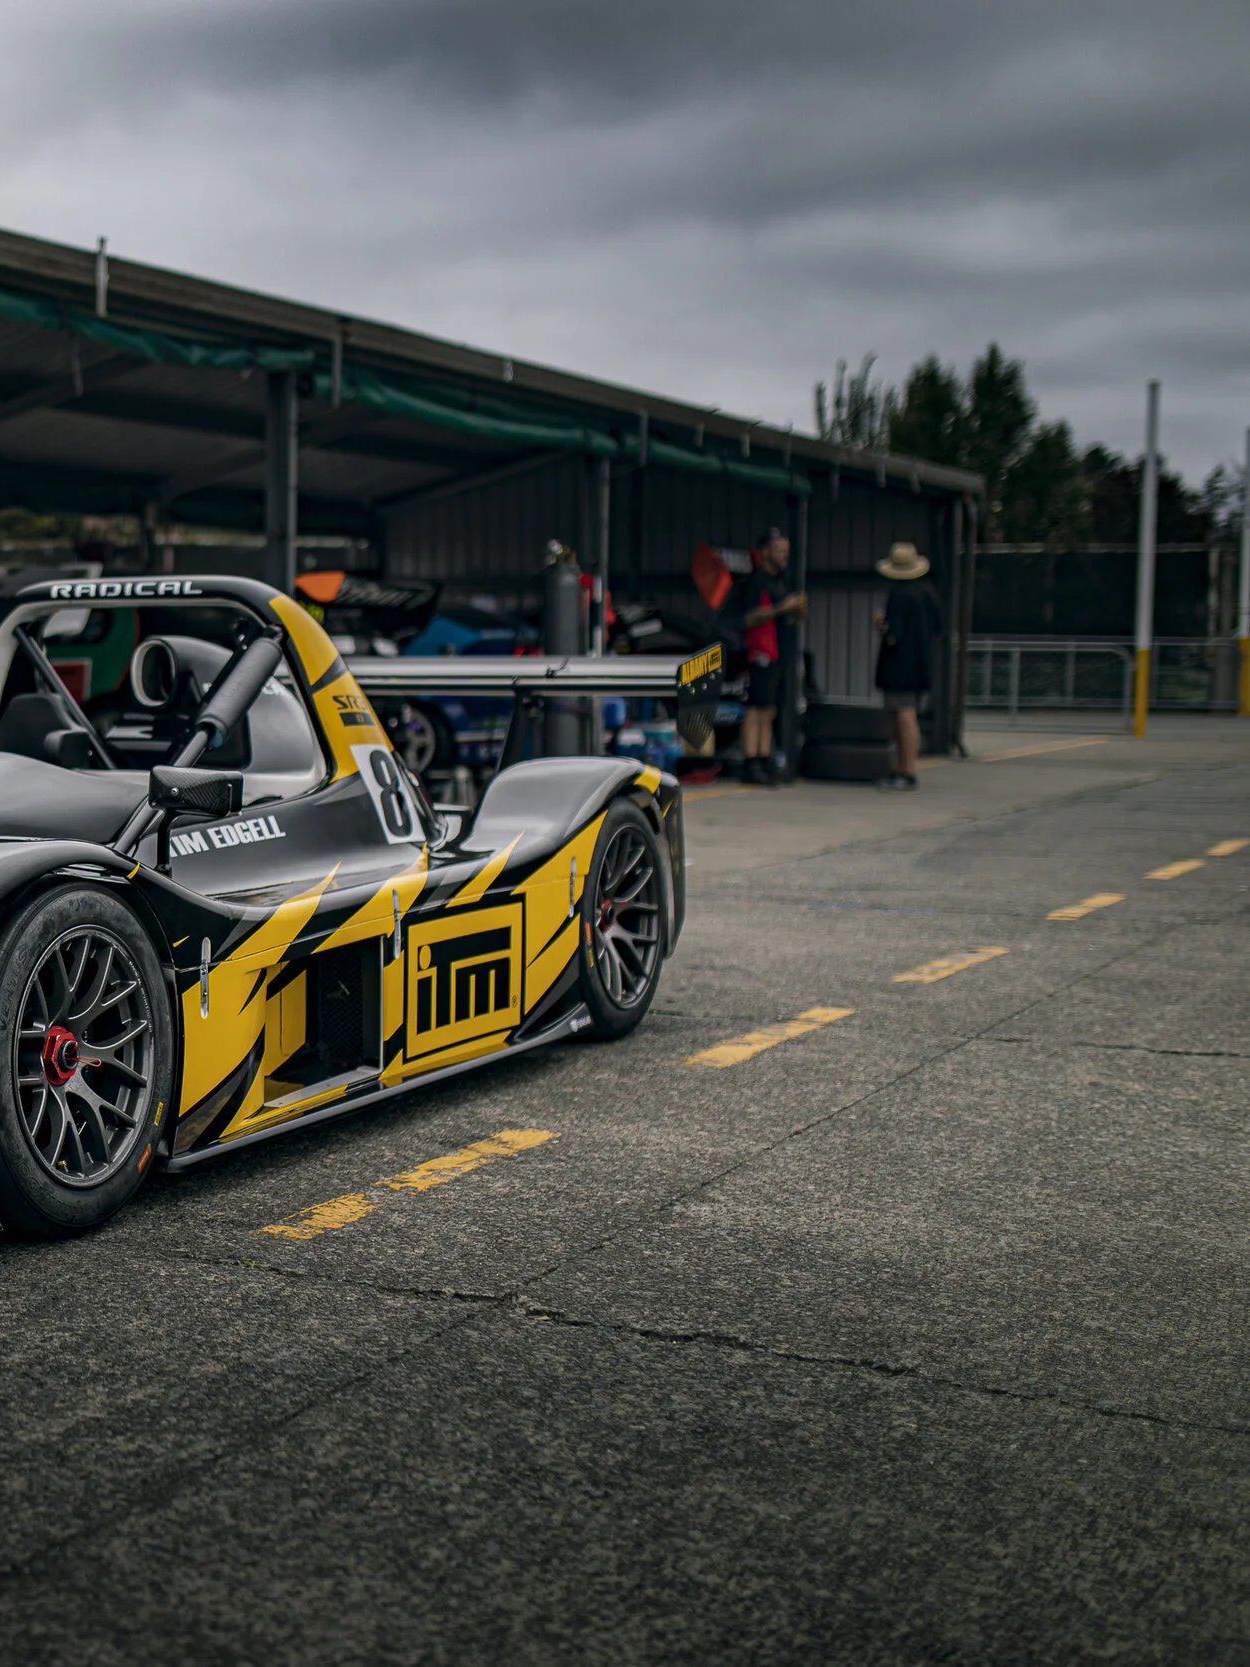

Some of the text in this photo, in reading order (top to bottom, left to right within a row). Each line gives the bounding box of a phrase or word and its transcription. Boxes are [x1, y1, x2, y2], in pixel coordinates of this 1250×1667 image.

[50, 580, 203, 598] RADICAL
[370, 750, 413, 837] 8
[207, 815, 286, 849] EDGELL
